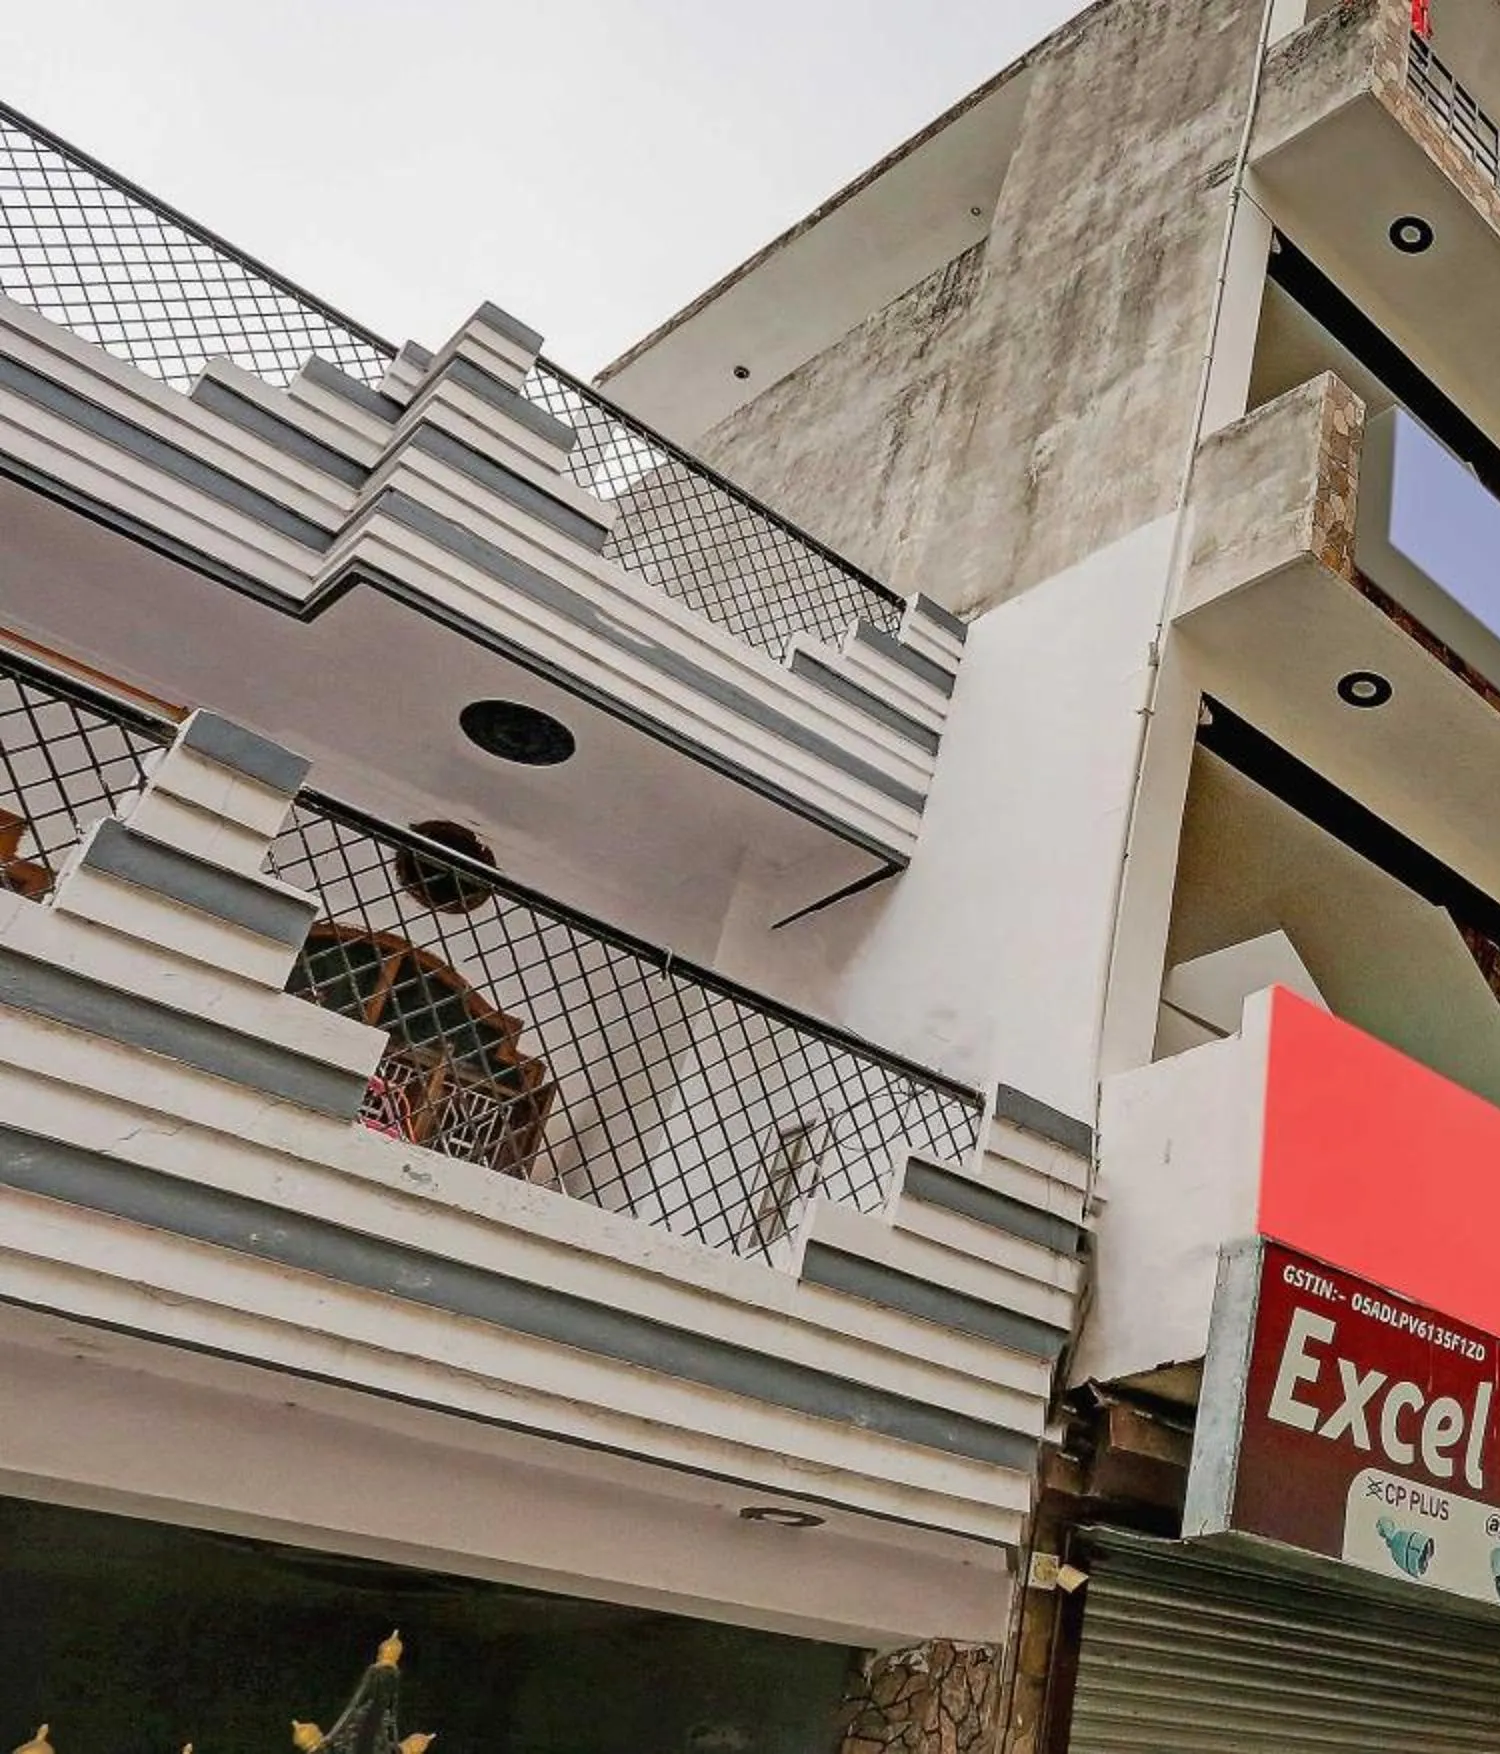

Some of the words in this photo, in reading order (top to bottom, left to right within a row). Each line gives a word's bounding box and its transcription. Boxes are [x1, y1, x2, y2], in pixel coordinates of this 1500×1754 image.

[1267, 1306, 1494, 1491] Excel
[1385, 1482, 1407, 1508] CP
[1409, 1490, 1450, 1521] PLUS
